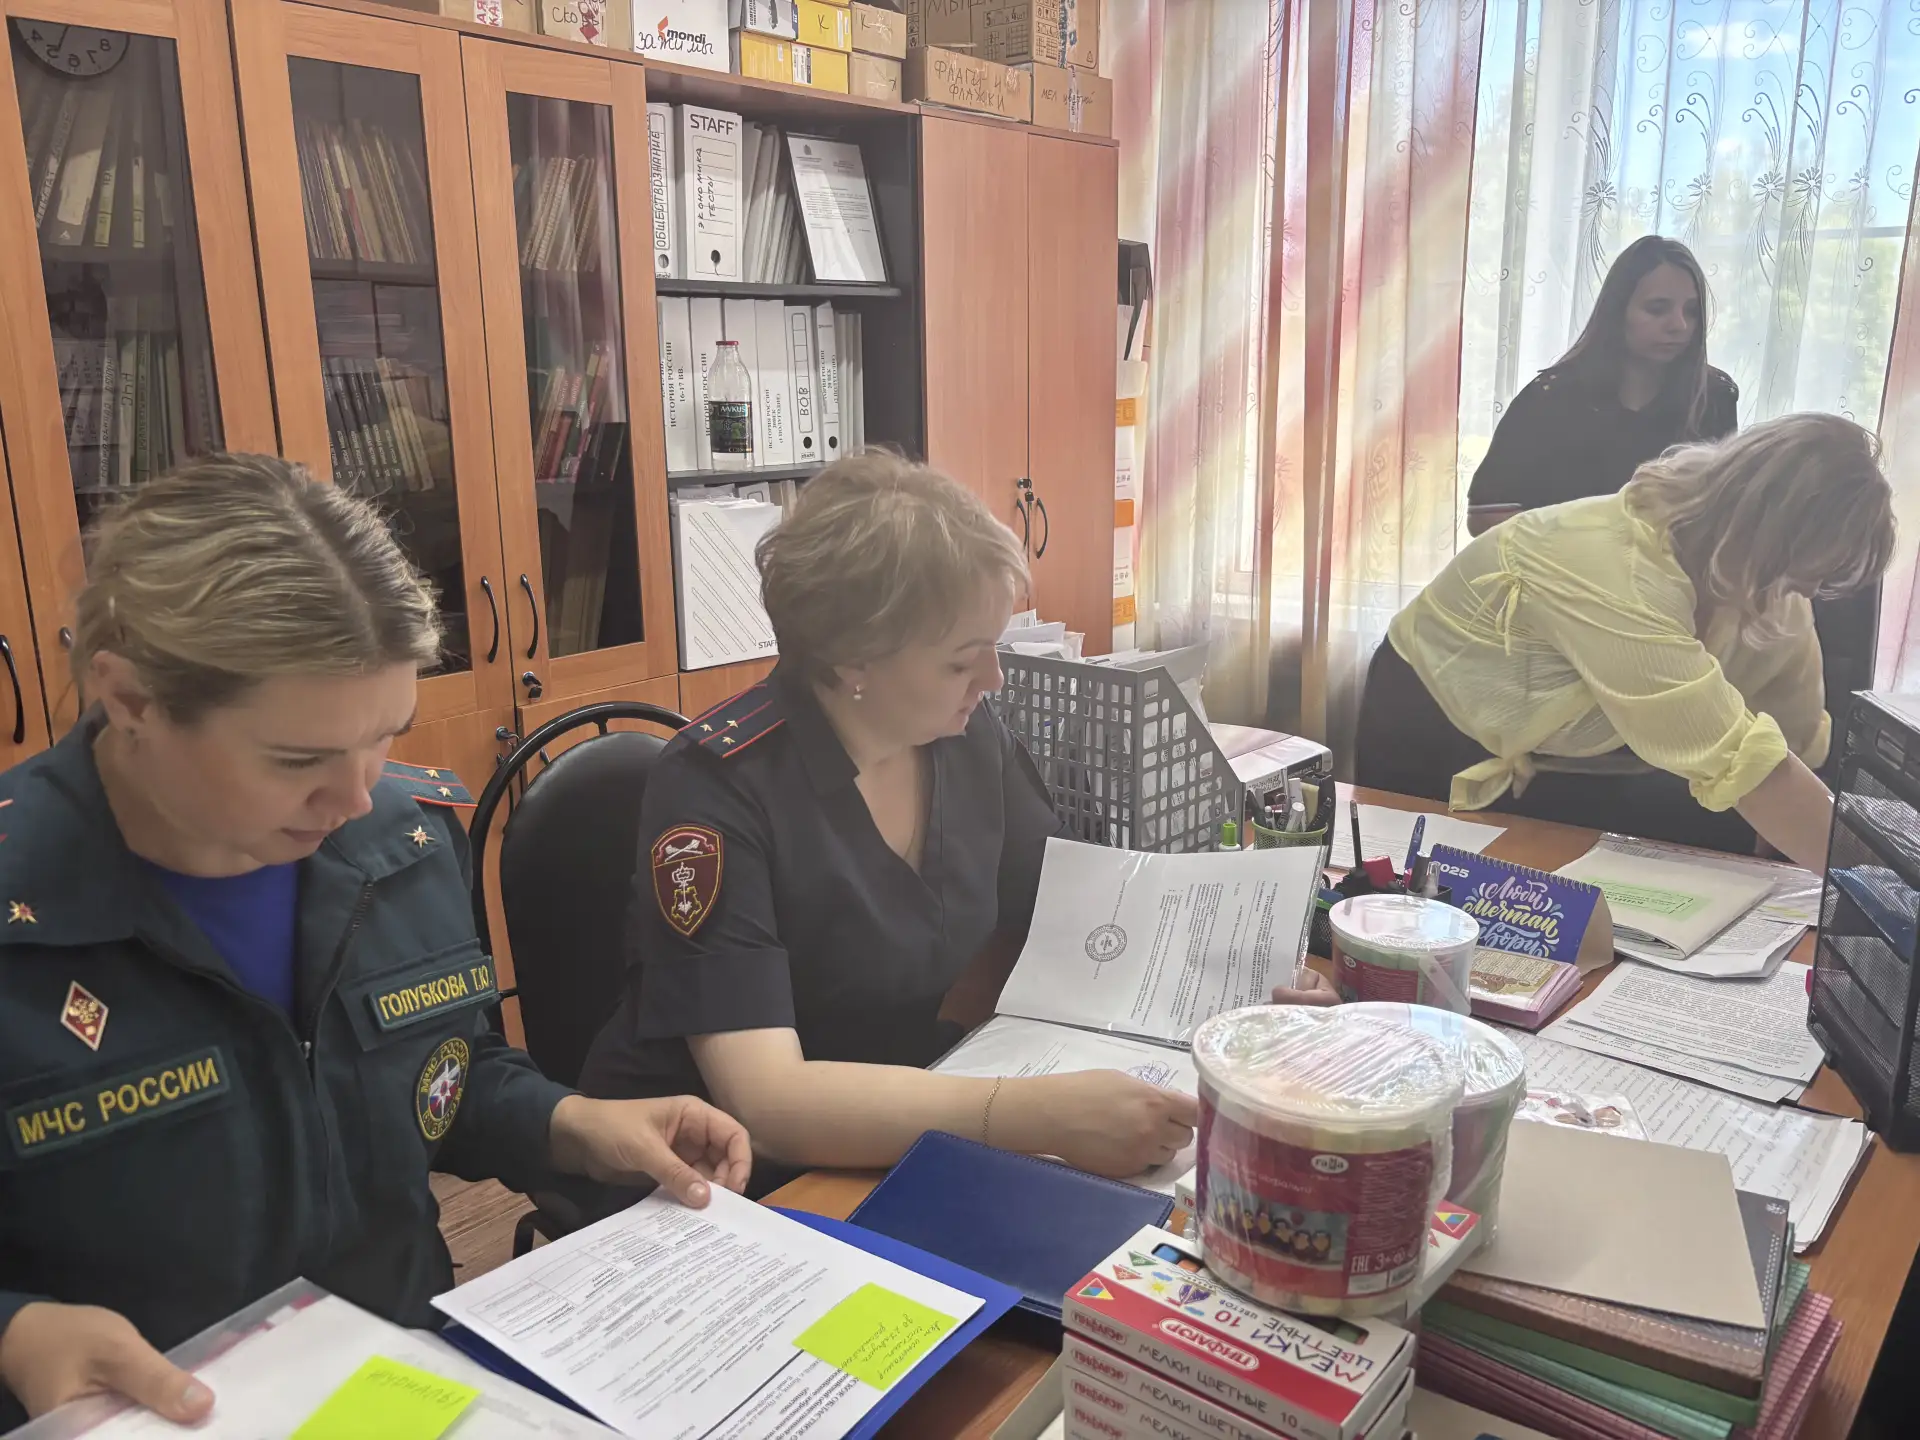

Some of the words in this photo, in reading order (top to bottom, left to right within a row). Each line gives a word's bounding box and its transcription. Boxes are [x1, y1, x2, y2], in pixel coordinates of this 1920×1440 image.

[665, 30, 707, 45] mondi
[690, 113, 736, 135] STAFF
[651, 130, 667, 248] ОБЩЕСТВОЗНАНИЕ
[697, 147, 705, 230] ЭКОНОМИКА
[708, 175, 717, 219] ТЕСТЫ
[700, 353, 708, 390] РОССИИ
[669, 382, 677, 428] ИСТОРИЯ
[703, 393, 711, 436] ИСТОРИЯ
[1485, 876, 1548, 911] Люби
[1461, 898, 1559, 938] Мечтай
[378, 973, 469, 1021] ГОЛУБКОВА
[17, 1103, 86, 1146] МЧС
[99, 1057, 219, 1122] РОССИИ
[1214, 1310, 1241, 1328] 10
[1166, 1323, 1251, 1366] ПИФАГОР
[1250, 1328, 1366, 1383] МЕЛКИ
[1263, 1316, 1374, 1370] ЦВЕТНЫЕ
[1138, 1344, 1190, 1375] МЕЛКИ
[1197, 1369, 1268, 1413] ЦВЕТНЫЕ
[1280, 1411, 1298, 1429] 10
[1139, 1382, 1191, 1413] МЕЛКИ
[1198, 1410, 1256, 1440] ЦВЕТН
